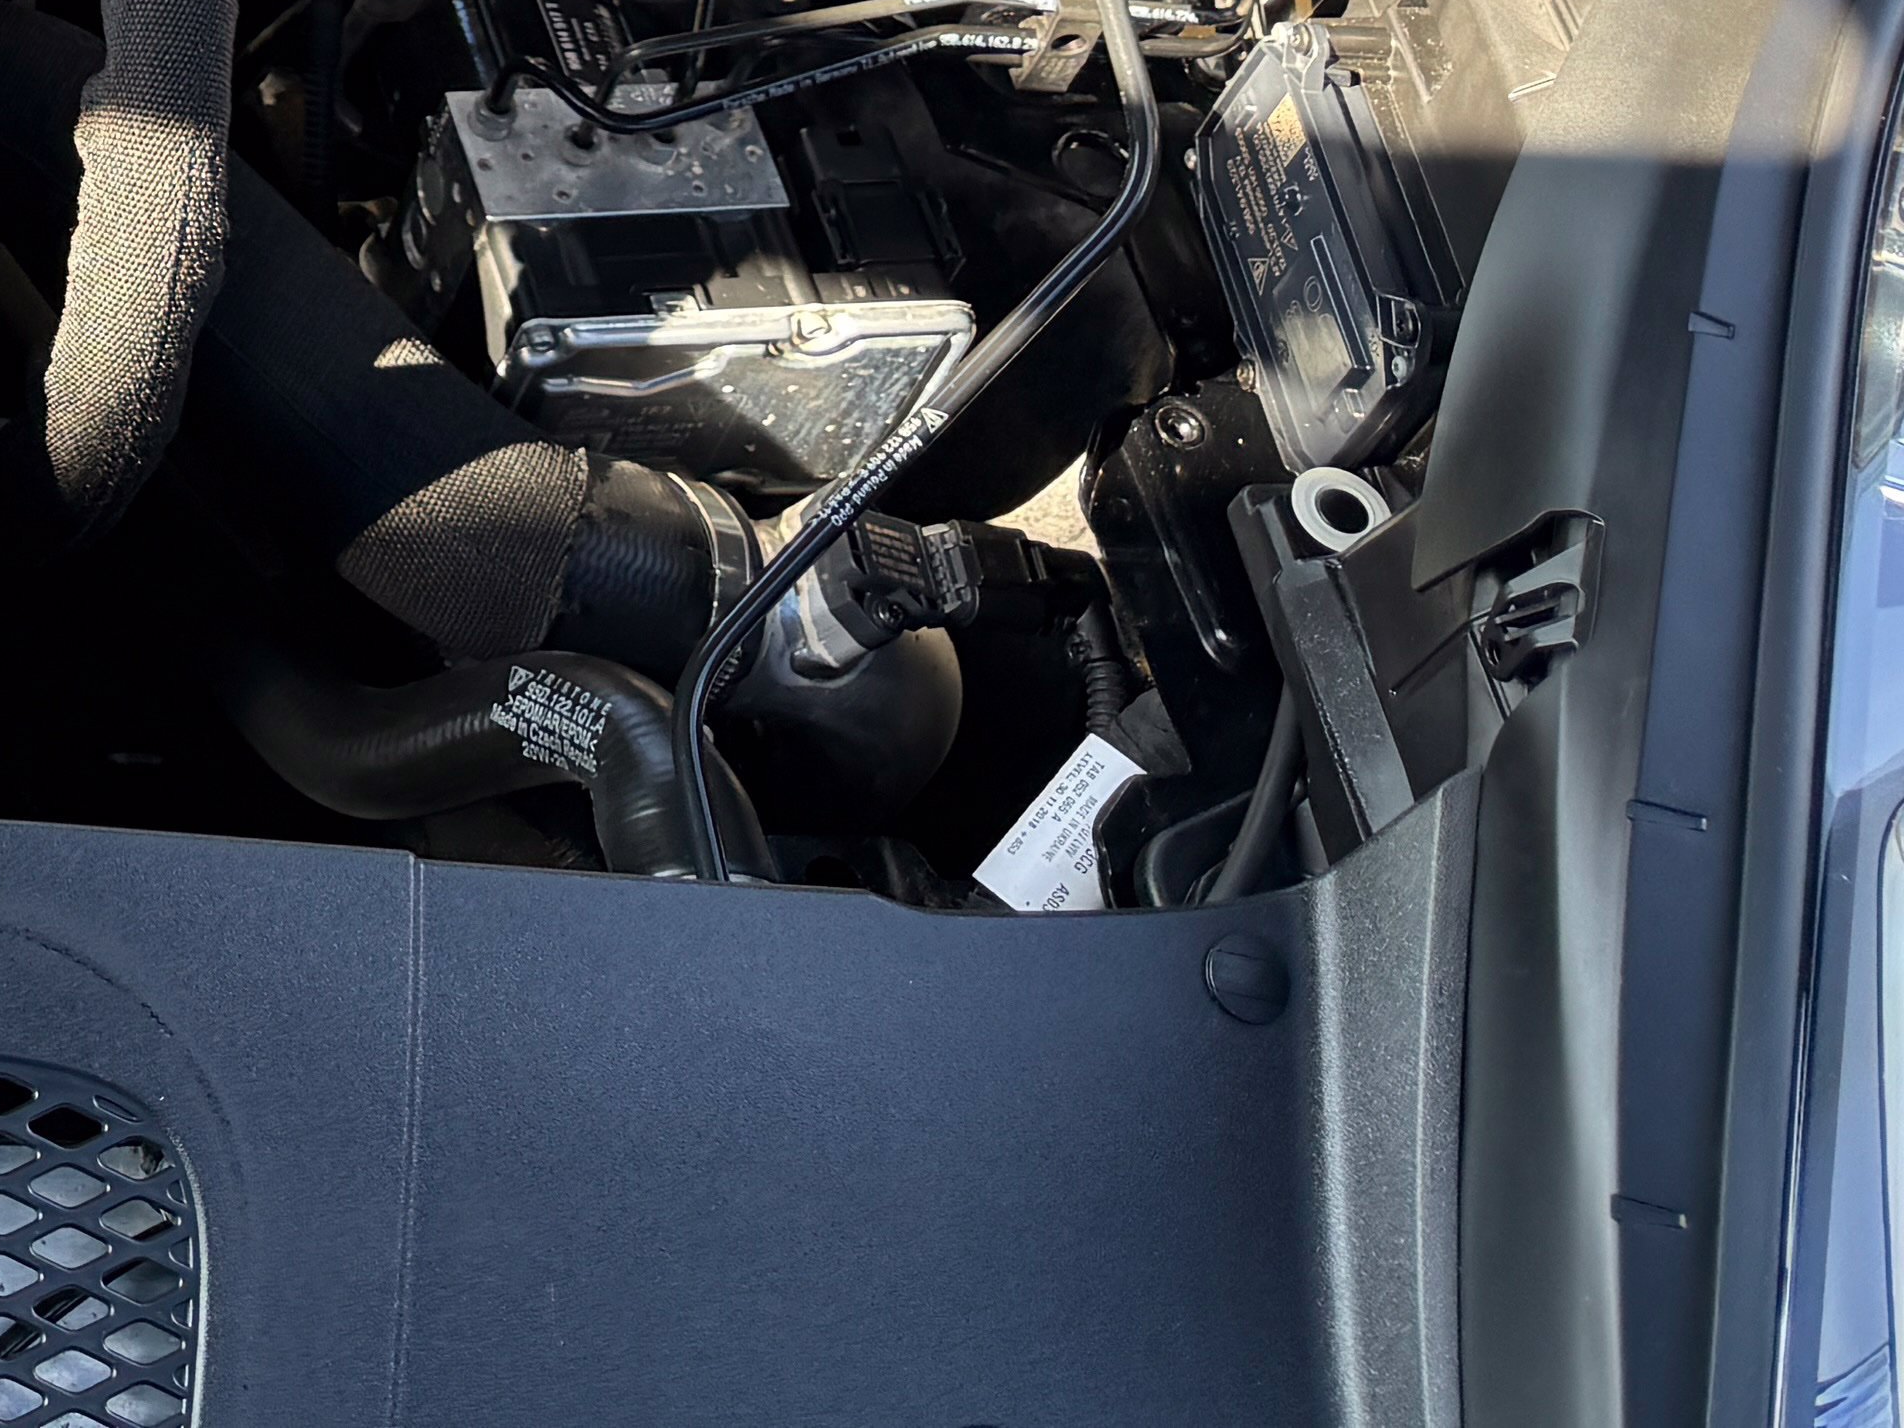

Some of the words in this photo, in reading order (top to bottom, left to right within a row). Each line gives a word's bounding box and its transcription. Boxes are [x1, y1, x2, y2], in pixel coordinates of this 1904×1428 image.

[892, 433, 924, 465] Made
[881, 458, 898, 475] in
[851, 468, 889, 506] Poland
[1041, 826, 1072, 863] UKRAINE
